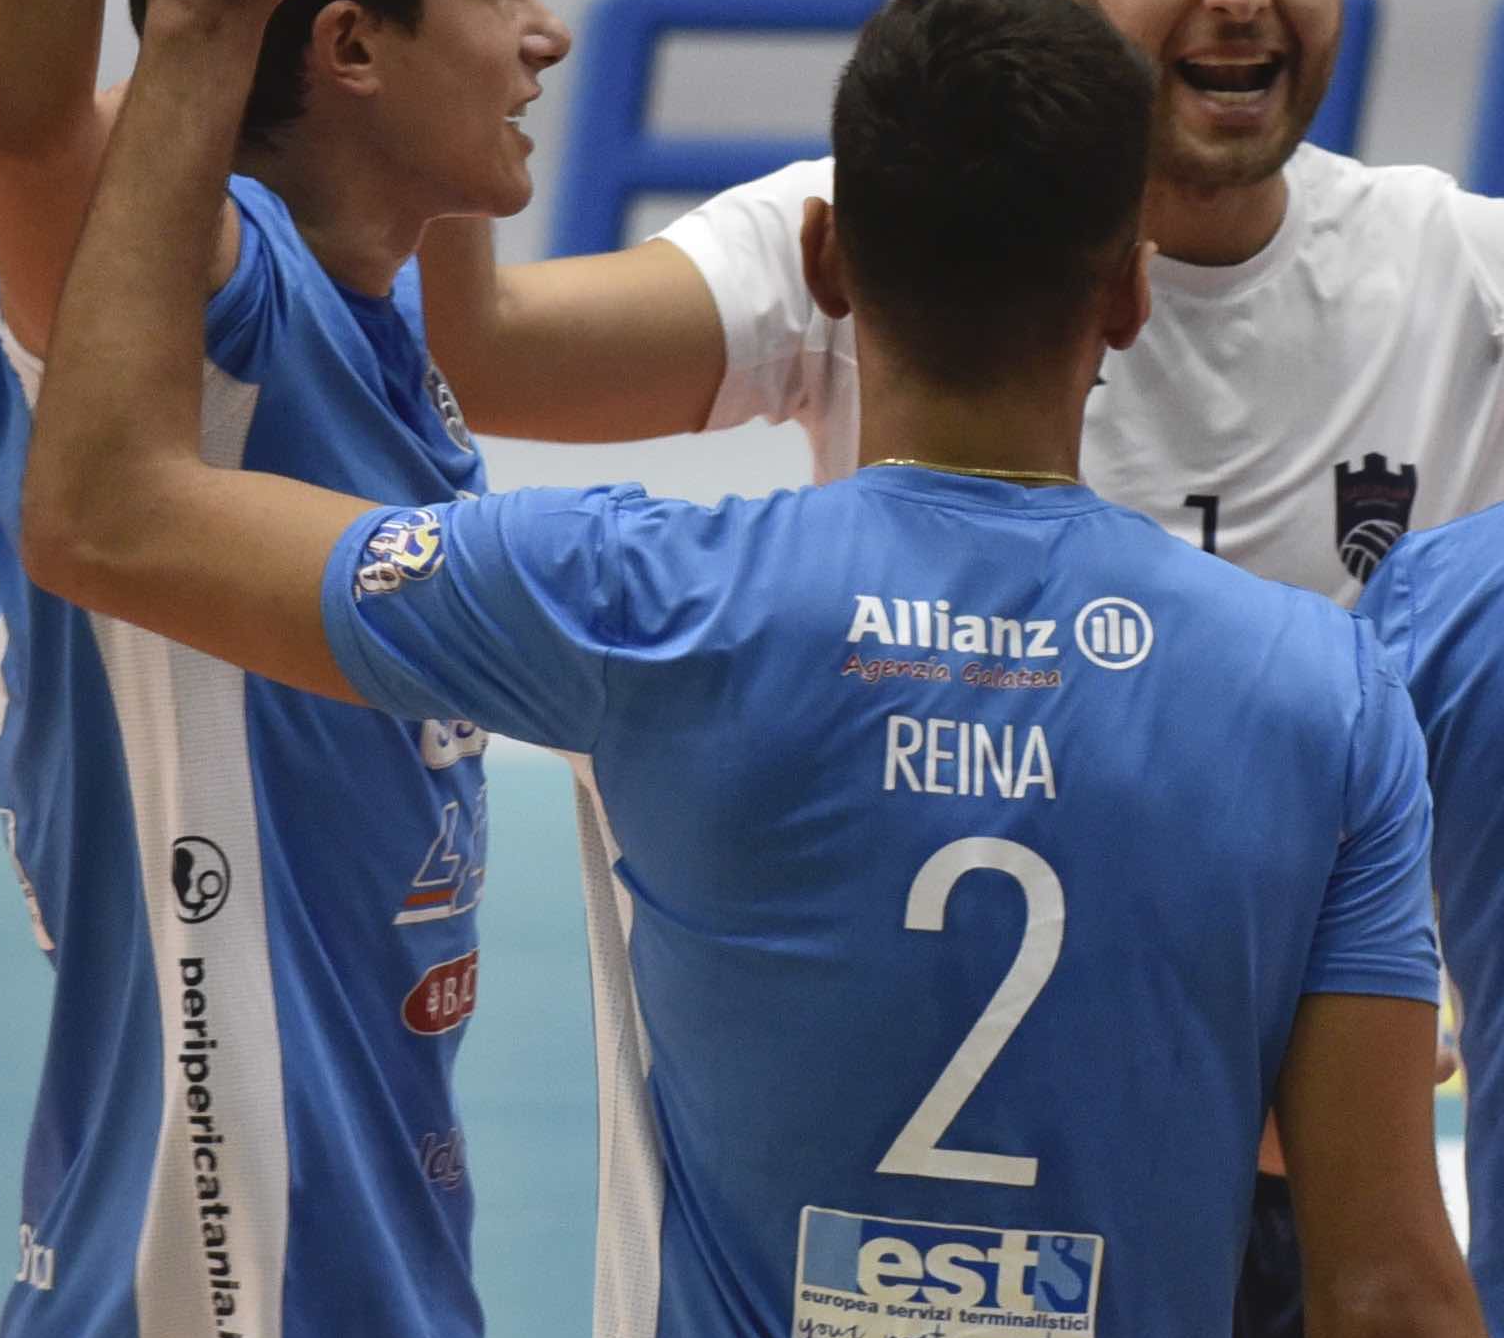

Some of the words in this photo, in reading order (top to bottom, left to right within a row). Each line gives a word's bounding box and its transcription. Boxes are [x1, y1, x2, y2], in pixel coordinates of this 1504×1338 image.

[847, 594, 1059, 658] Allianz
[841, 653, 951, 683] Agenzia
[960, 661, 1062, 688] Galatea
[883, 716, 1056, 800] REINA
[875, 837, 1066, 1187] 2
[856, 1230, 1040, 1310] est
[801, 1288, 878, 1314] europea
[886, 1302, 951, 1322] servizi
[959, 1309, 1089, 1331] terminalistici
